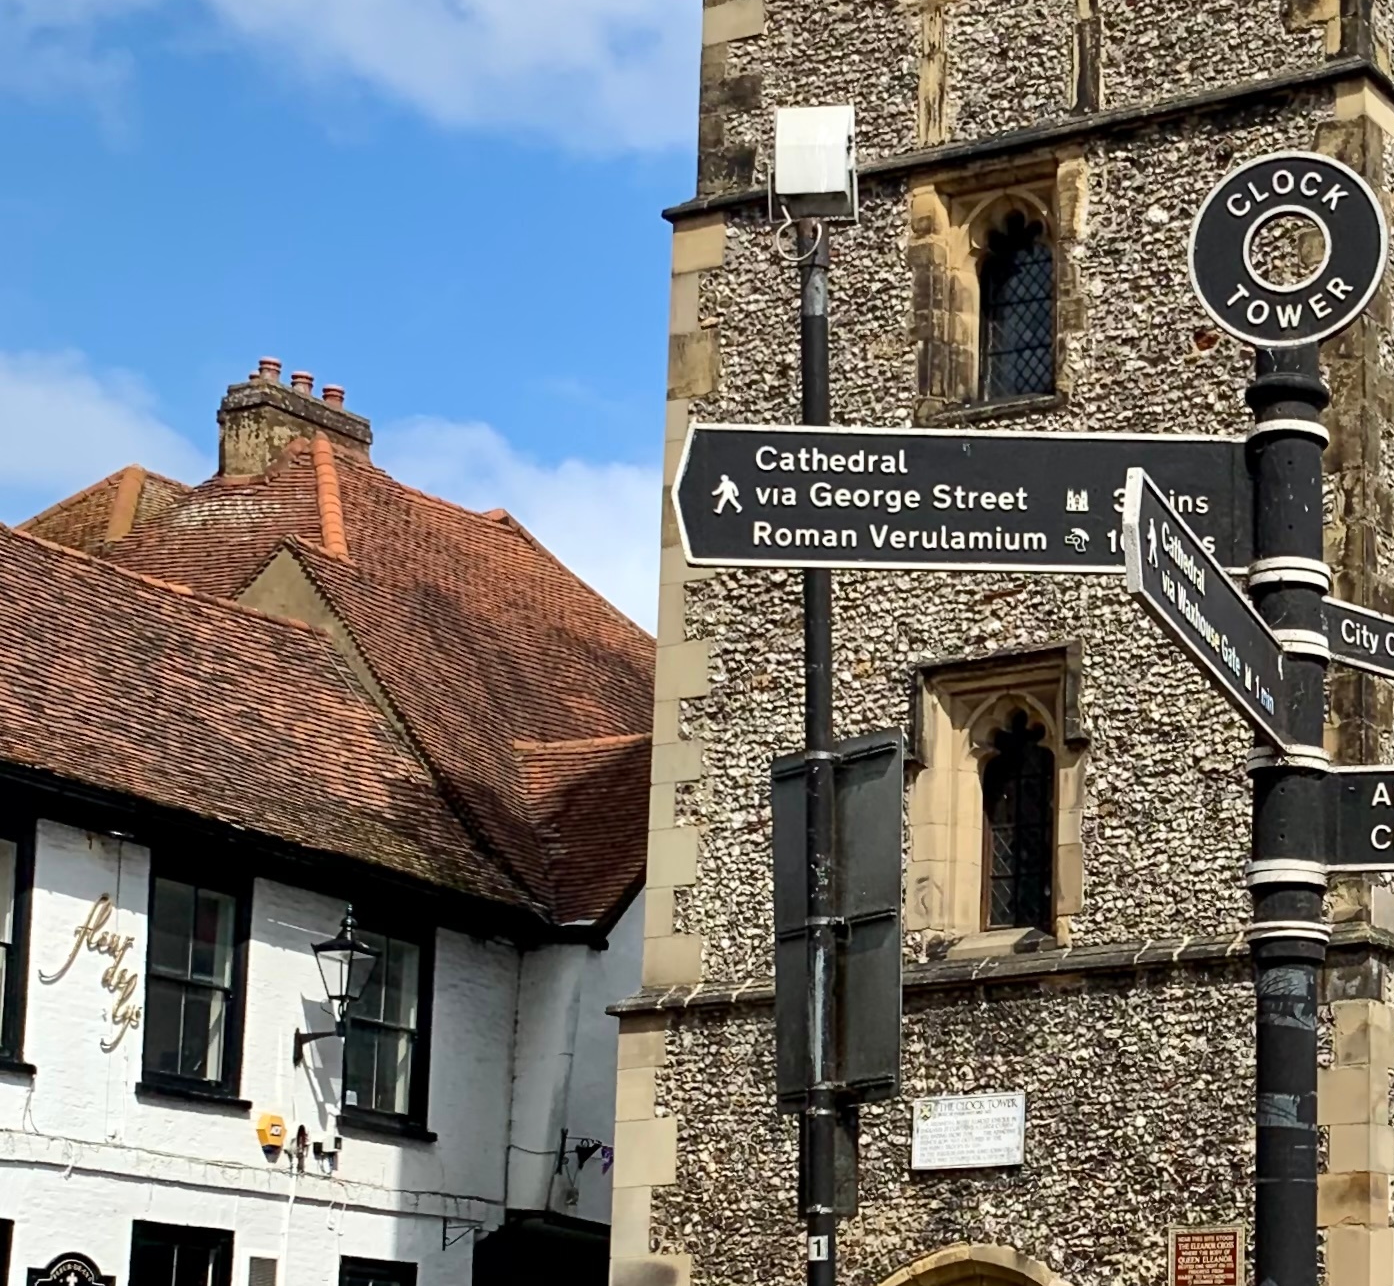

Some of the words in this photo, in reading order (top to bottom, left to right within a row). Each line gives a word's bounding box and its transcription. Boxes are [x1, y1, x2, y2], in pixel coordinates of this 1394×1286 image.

[1227, 169, 1349, 216] CLOCK
[1227, 277, 1354, 328] TOWER
[755, 446, 908, 474] Cathedral
[756, 485, 797, 507] via
[809, 481, 921, 513] George
[933, 484, 1029, 511] Street
[1168, 489, 1209, 514] ins
[753, 521, 858, 548] Roman
[869, 524, 1048, 551] Verulamium
[1161, 521, 1206, 596] Cathedral
[1161, 570, 1176, 604] via
[1177, 581, 1221, 653] Waxhouse
[1221, 634, 1241, 677] Gate
[1261, 687, 1275, 715] min
[1341, 618, 1379, 654] City
[940, 1101, 954, 1112] THE
[956, 1100, 984, 1111] CLOCK
[988, 1098, 1018, 1108] TOWER
[812, 1239, 821, 1257] 1
[1178, 1257, 1200, 1265] QUEEN
